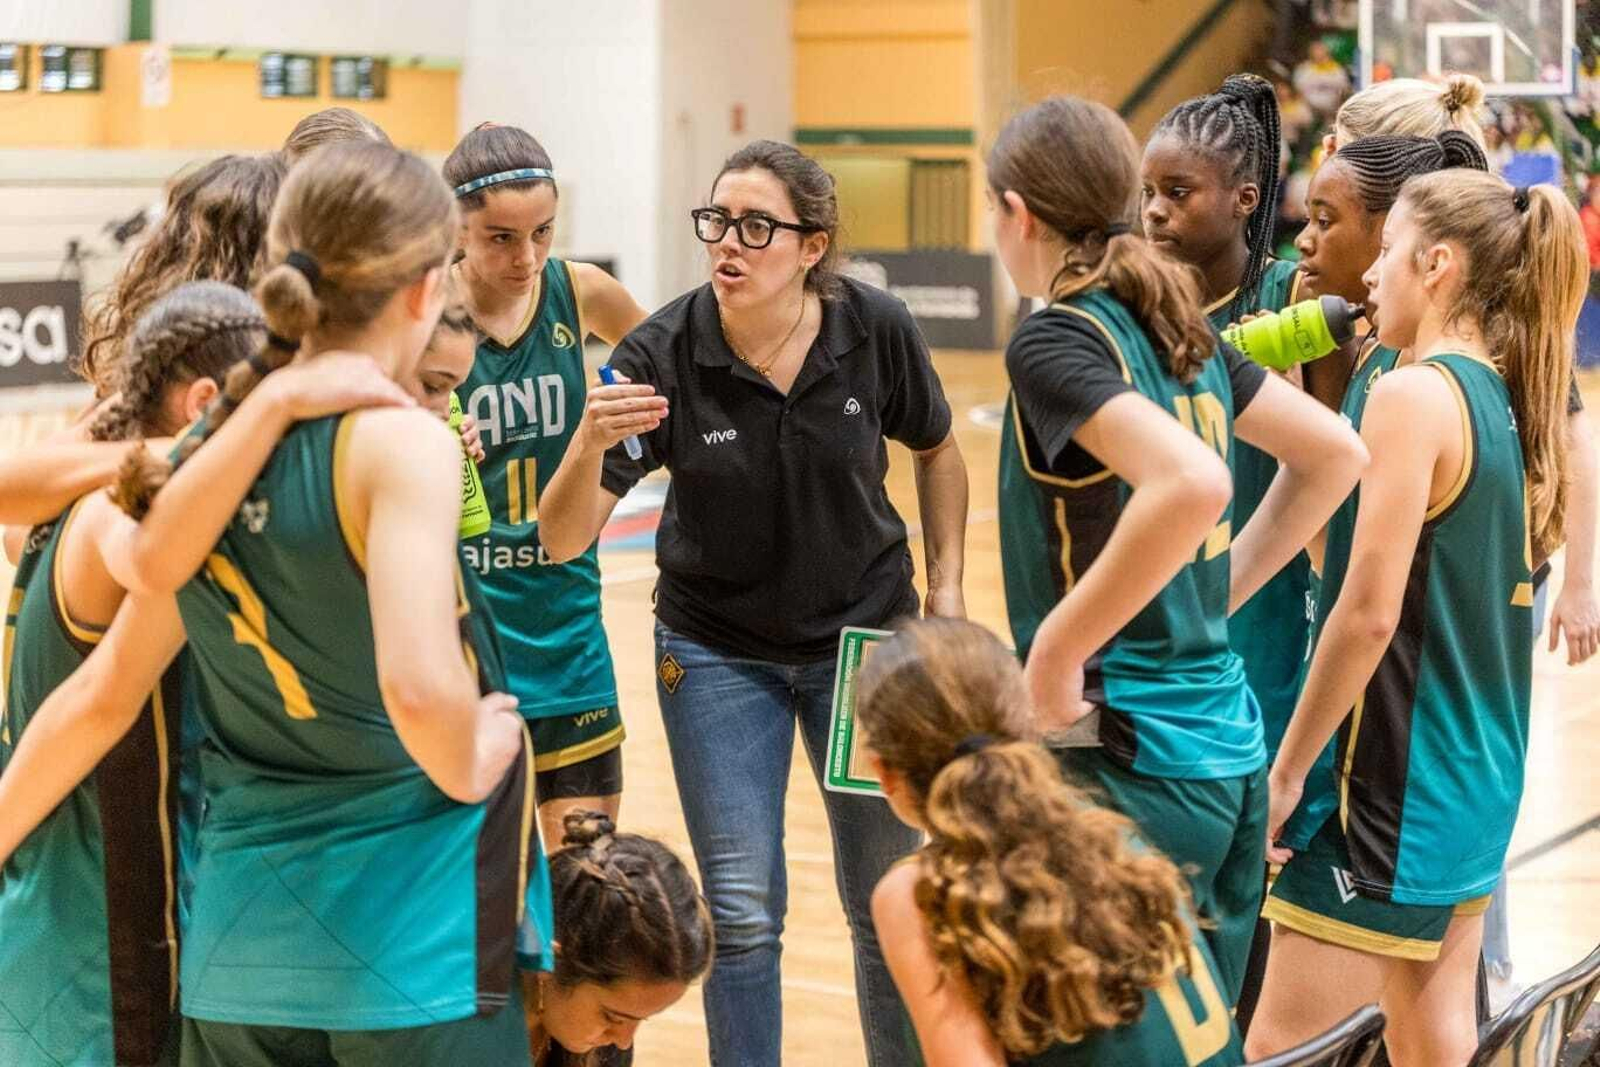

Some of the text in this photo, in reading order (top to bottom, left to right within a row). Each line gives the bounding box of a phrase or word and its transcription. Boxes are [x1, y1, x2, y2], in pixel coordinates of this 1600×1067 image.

[467, 374, 566, 446] AND
[702, 429, 737, 445] vive
[507, 457, 539, 525] 11
[573, 707, 609, 727] vive
